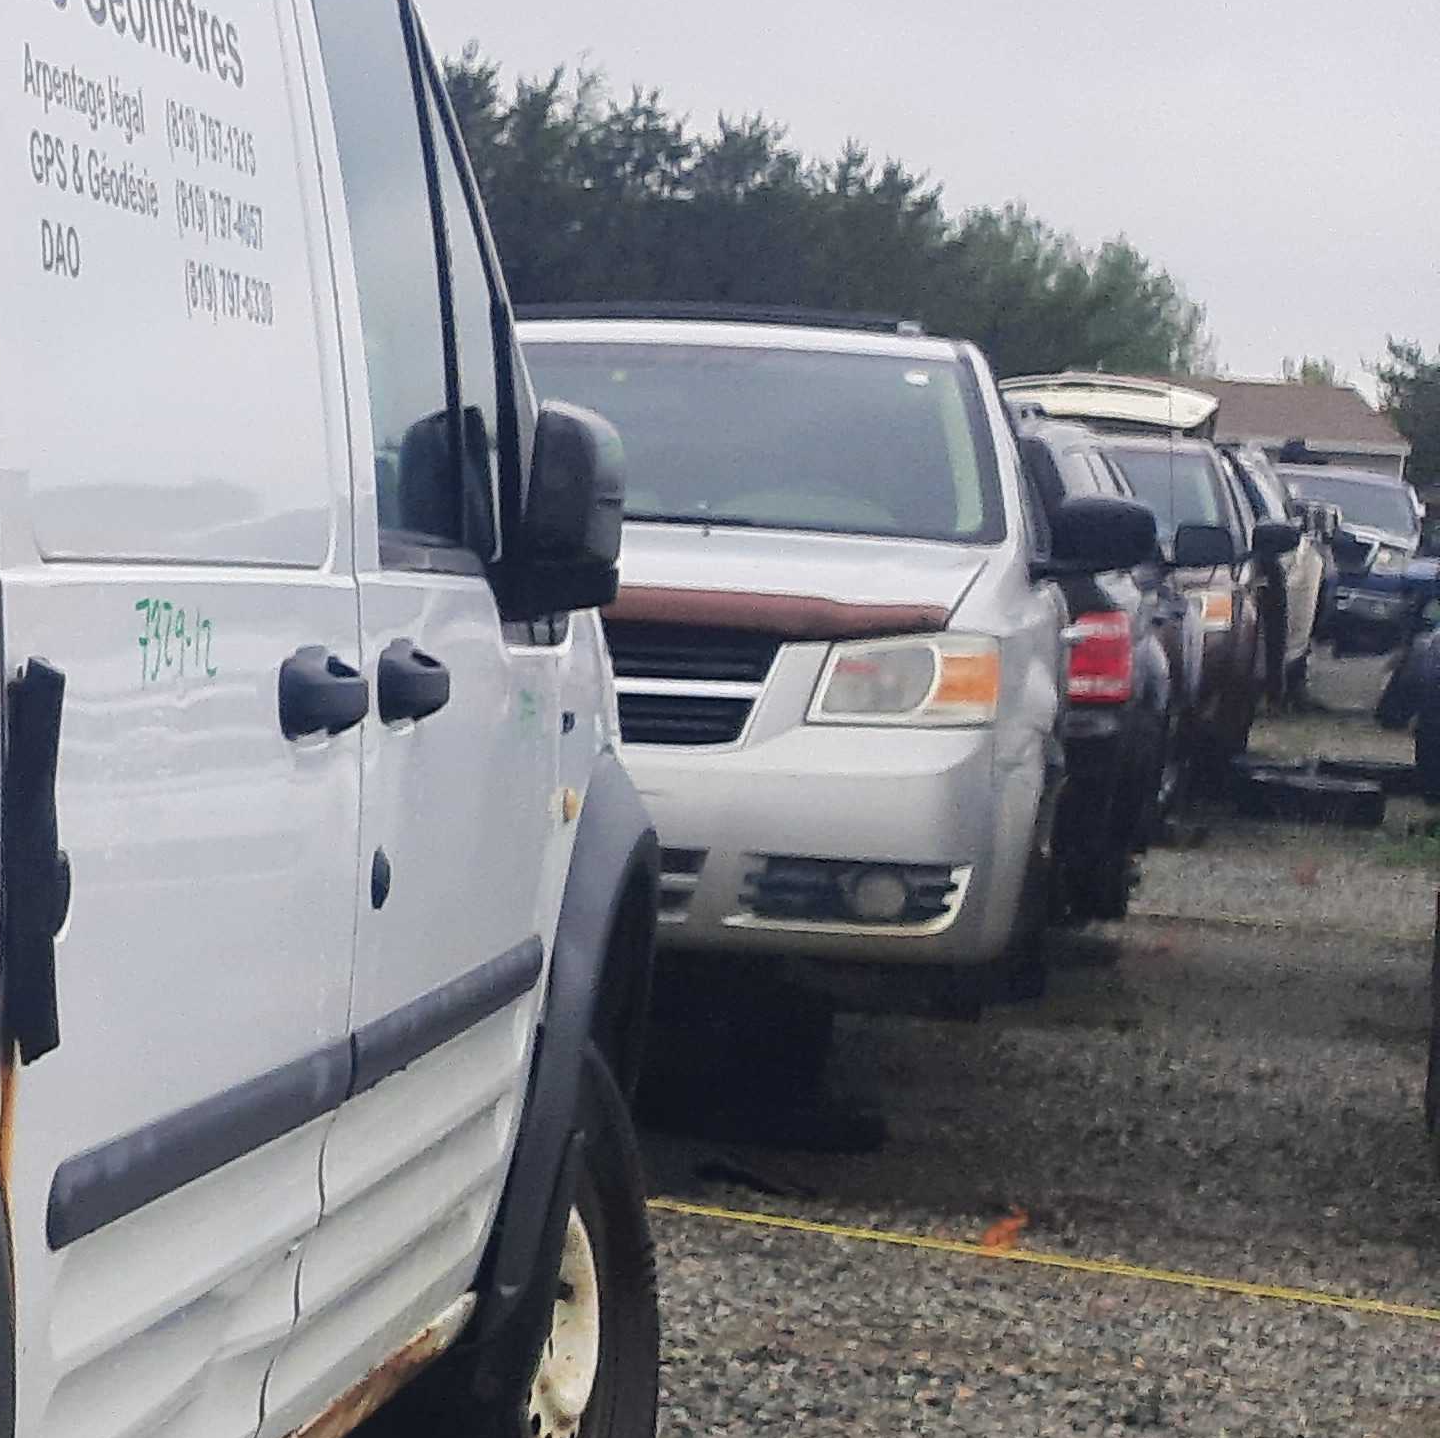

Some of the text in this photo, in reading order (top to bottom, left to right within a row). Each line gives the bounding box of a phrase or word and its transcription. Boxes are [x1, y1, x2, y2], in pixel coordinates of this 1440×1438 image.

[24, 42, 145, 144] Arpentage légal
[166, 99, 199, 167] (819)
[30, 128, 159, 218] GPS & Géodésie
[41, 219, 80, 278] DAO
